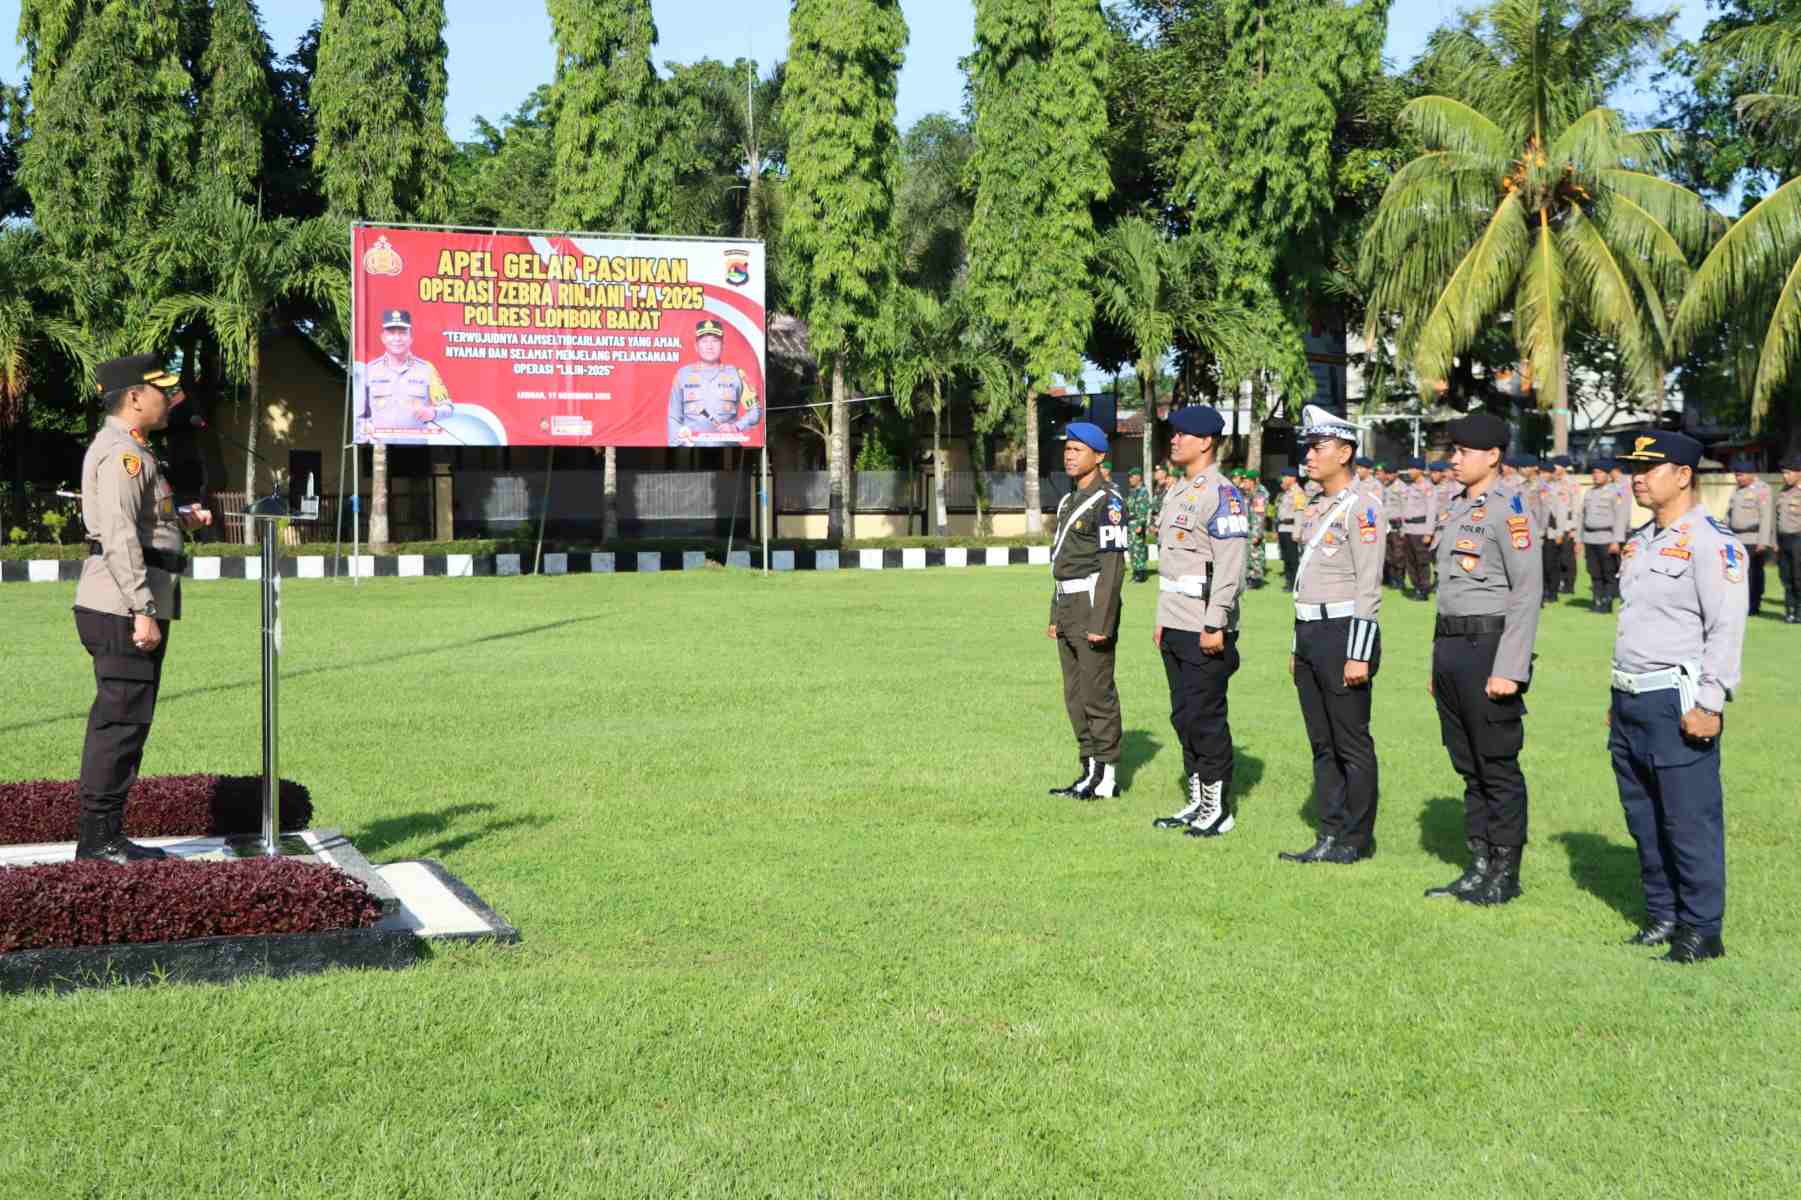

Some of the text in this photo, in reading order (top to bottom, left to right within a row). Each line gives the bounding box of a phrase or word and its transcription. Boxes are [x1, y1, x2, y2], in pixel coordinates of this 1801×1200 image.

[437, 249, 688, 284] APEL GELAR PASUKAN
[419, 277, 494, 304] OPERASI
[497, 281, 553, 306] ZEBRA
[557, 283, 625, 308] RINJANI
[661, 286, 704, 310] 2025
[464, 305, 661, 331] POLRES LOMBOK BARAT
[628, 336, 652, 348] YANG
[446, 346, 680, 363] NYAMAN DAN SELAMAT MENJELANG PELAKSANAAN
[513, 363, 554, 375] OPERASI
[1099, 525, 1128, 549] PM
[1460, 524, 1485, 535] POLRI
